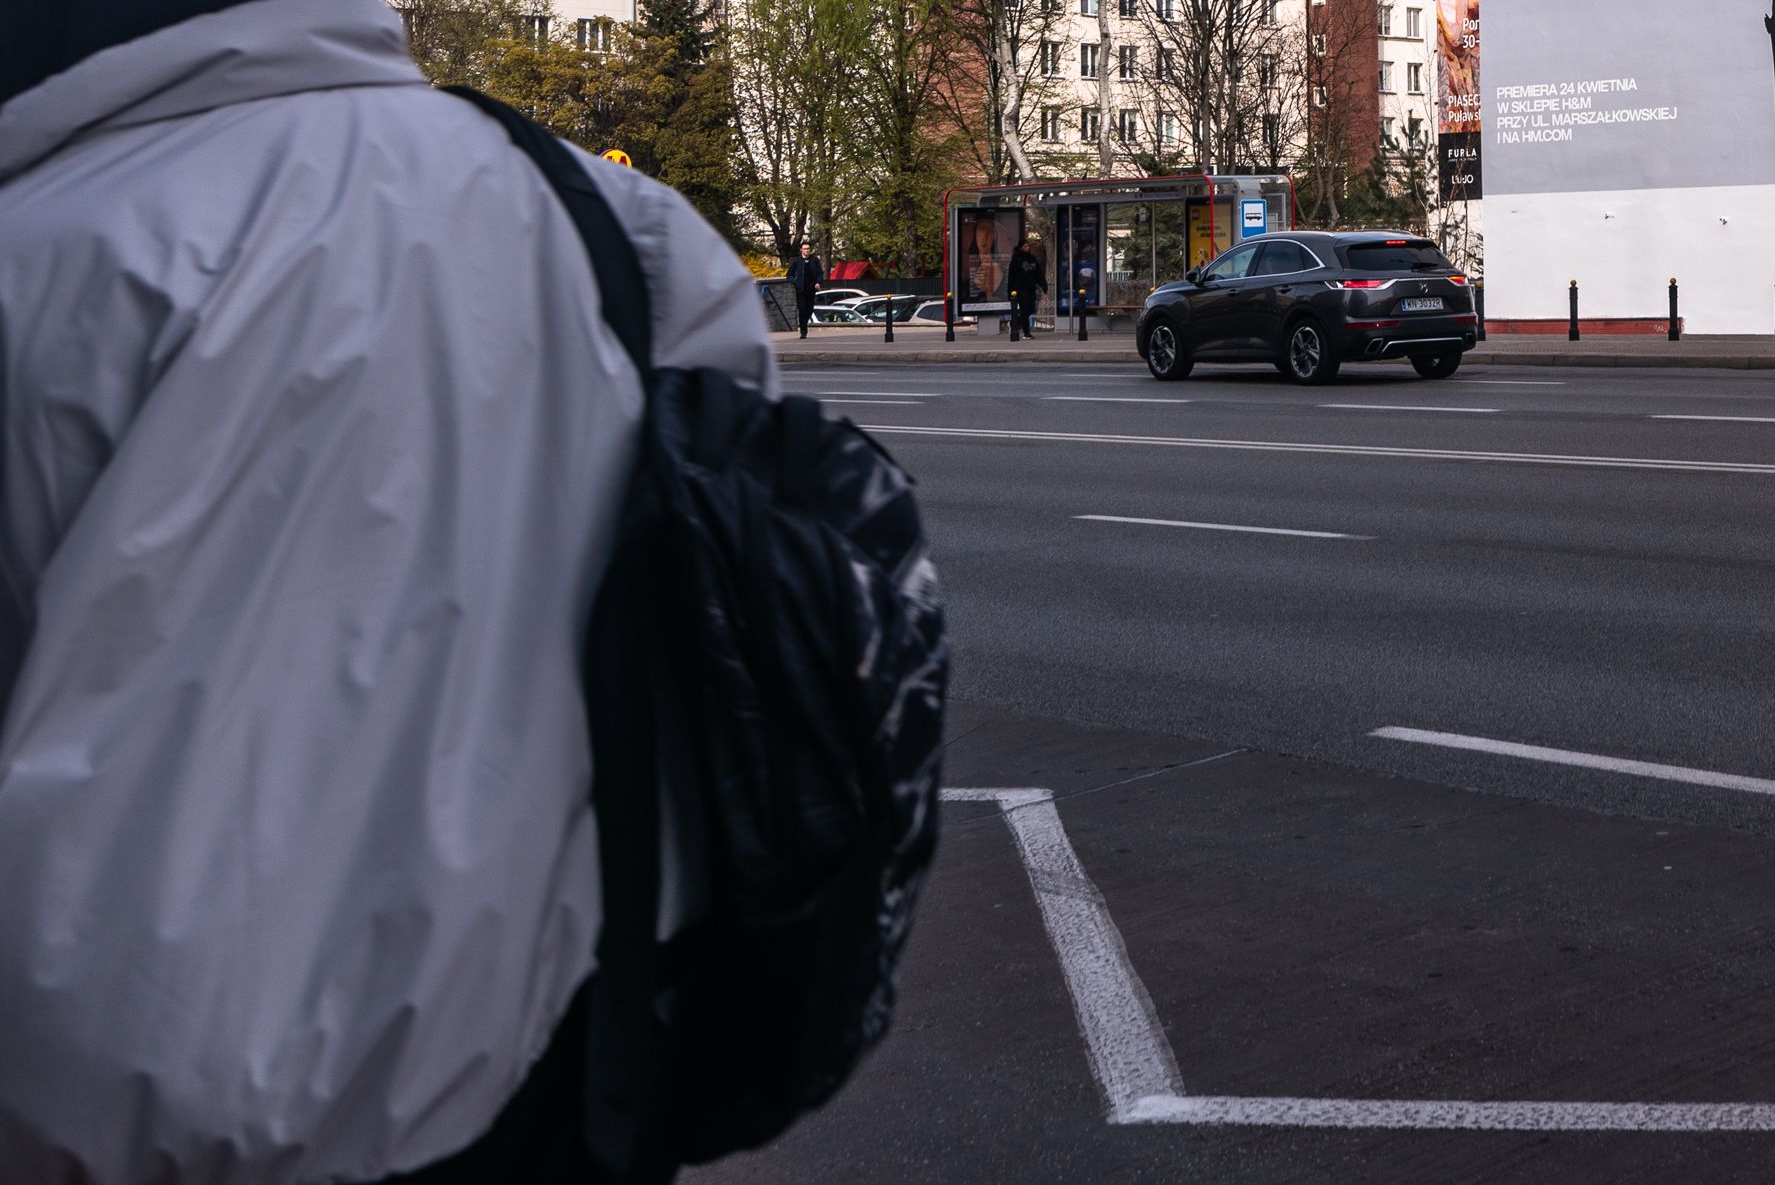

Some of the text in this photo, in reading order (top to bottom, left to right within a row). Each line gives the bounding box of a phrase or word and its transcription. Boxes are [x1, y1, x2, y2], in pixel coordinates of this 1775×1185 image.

[1497, 78, 1637, 99] PREMIERA 24 KWIETNIA
[1497, 97, 1592, 114] W SKLEPIE H&M
[1497, 116, 1528, 129] PRZY
[1552, 107, 1677, 126] MARSZAŁKOWSKIEJ
[1502, 131, 1520, 143] NA
[1522, 128, 1572, 143] HM.COM
[1448, 148, 1477, 158] FURLA
